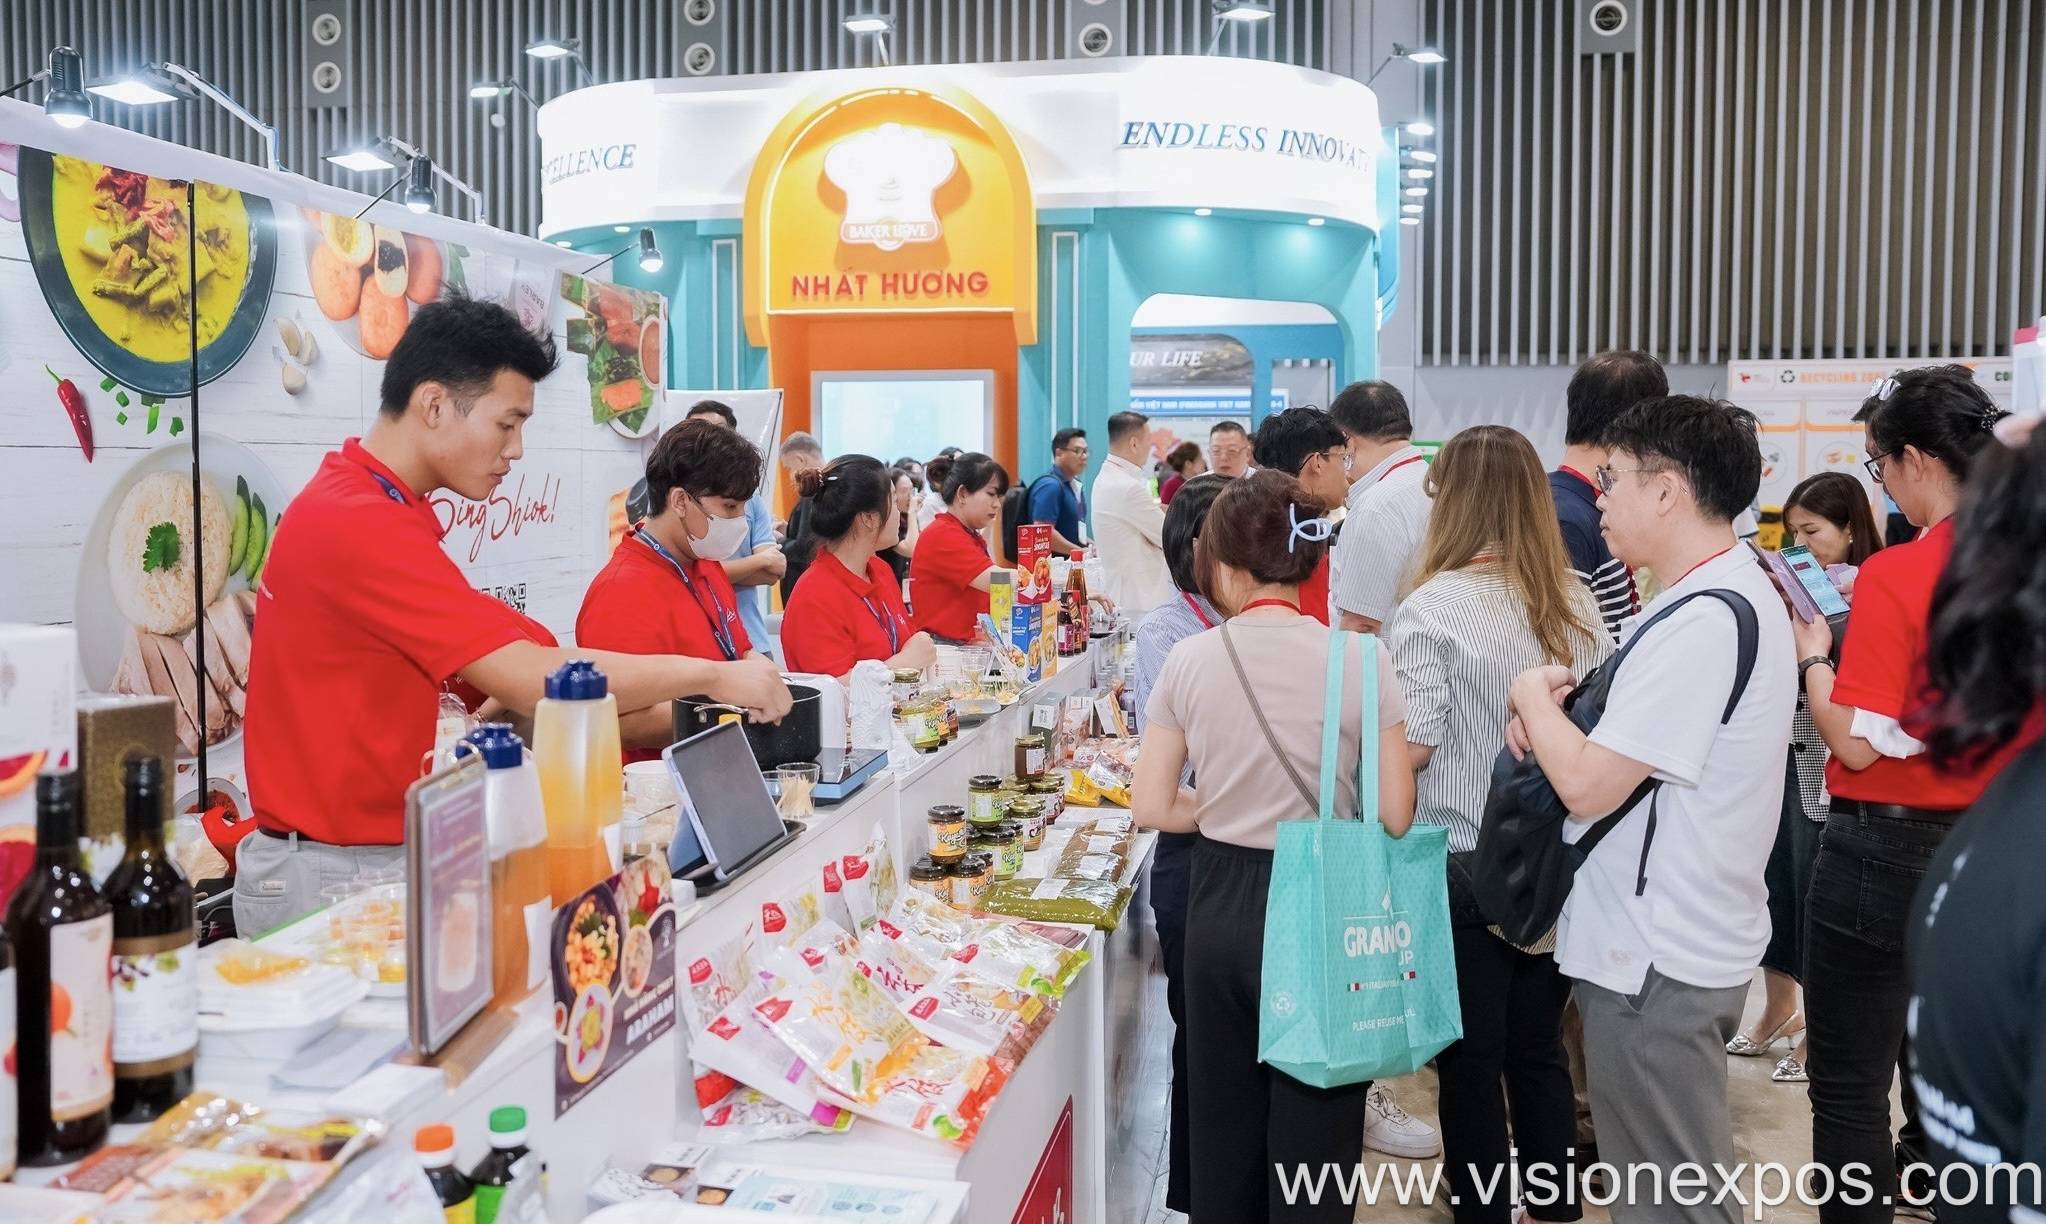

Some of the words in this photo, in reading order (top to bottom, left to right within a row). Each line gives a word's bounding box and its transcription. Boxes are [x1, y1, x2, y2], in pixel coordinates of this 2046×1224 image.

[1121, 121, 1268, 152] ENDLESS
[849, 224, 890, 238] BAKER
[792, 266, 868, 296] NHẤT
[881, 270, 989, 295] HƯƠNG
[1129, 351, 1155, 368] UR
[1161, 351, 1202, 367] LIFE
[1343, 920, 1412, 958] GRANO
[1398, 950, 1414, 966] JP
[1352, 1020, 1376, 1032] PLEASE
[1377, 1017, 1397, 1028] REUSE
